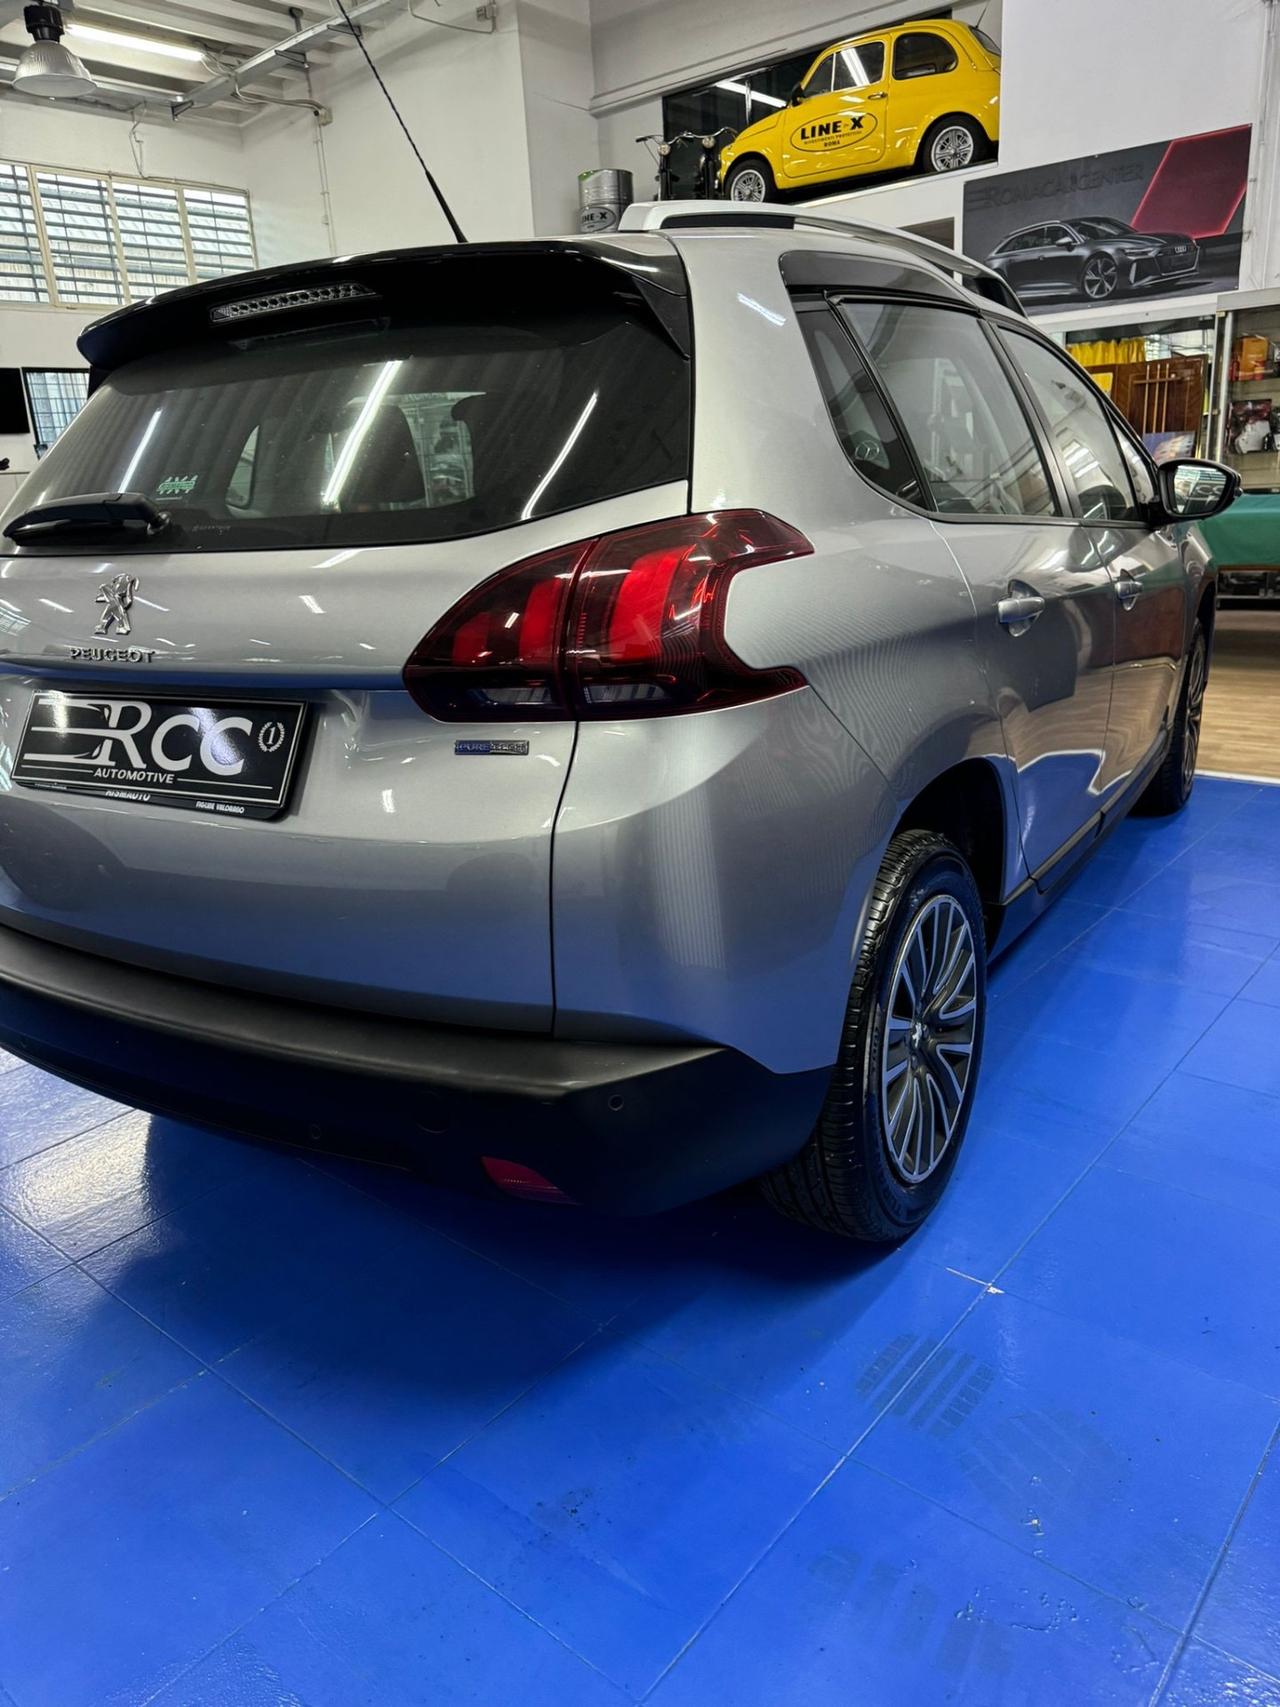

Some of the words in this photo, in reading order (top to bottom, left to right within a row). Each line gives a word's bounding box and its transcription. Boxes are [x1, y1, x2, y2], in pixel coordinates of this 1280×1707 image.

[824, 140, 841, 148] ROMA
[70, 647, 156, 664] PEUGEOT
[88, 700, 253, 777] RCC
[93, 766, 175, 785] AUTOMOTIVE
